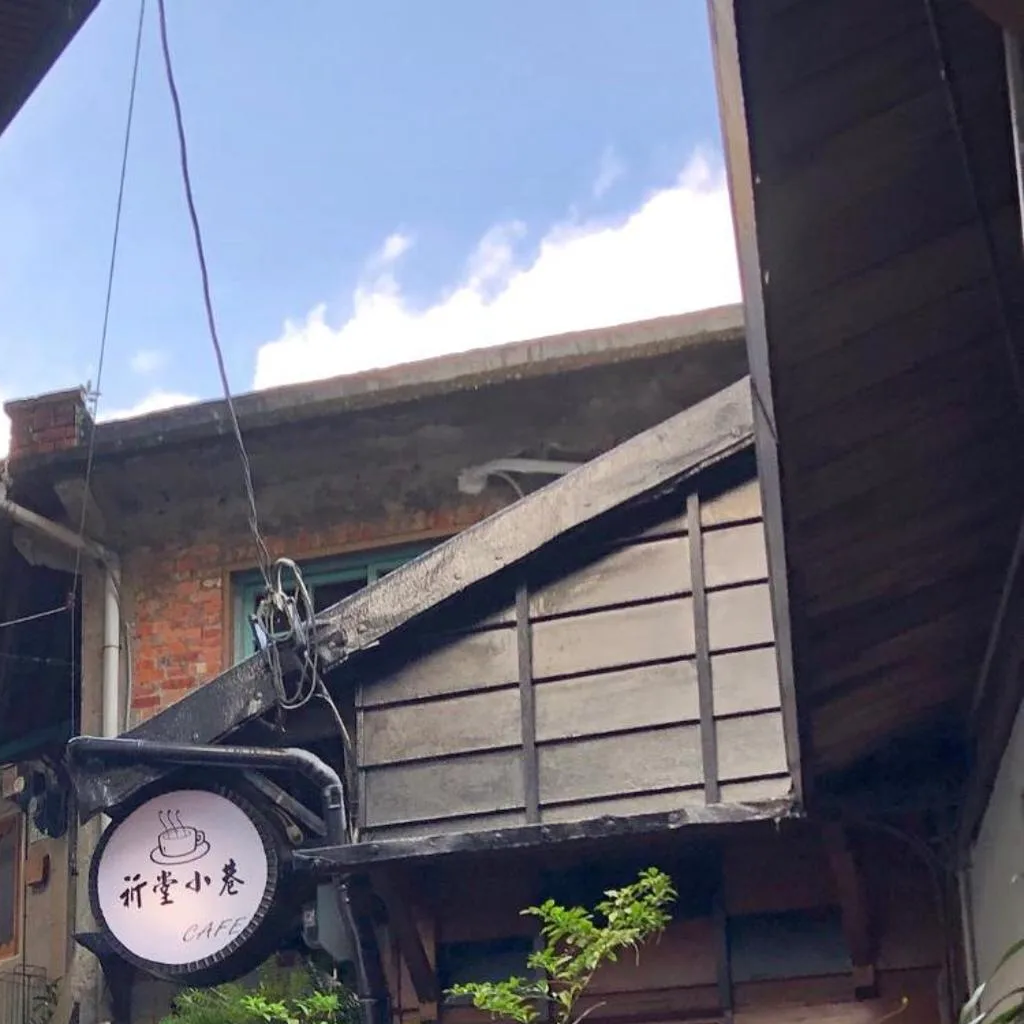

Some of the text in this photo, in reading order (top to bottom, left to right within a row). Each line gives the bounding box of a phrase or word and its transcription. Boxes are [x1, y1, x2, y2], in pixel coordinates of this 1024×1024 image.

[119, 858, 245, 909] 祈堂小巷
[182, 916, 248, 943] CAFE
